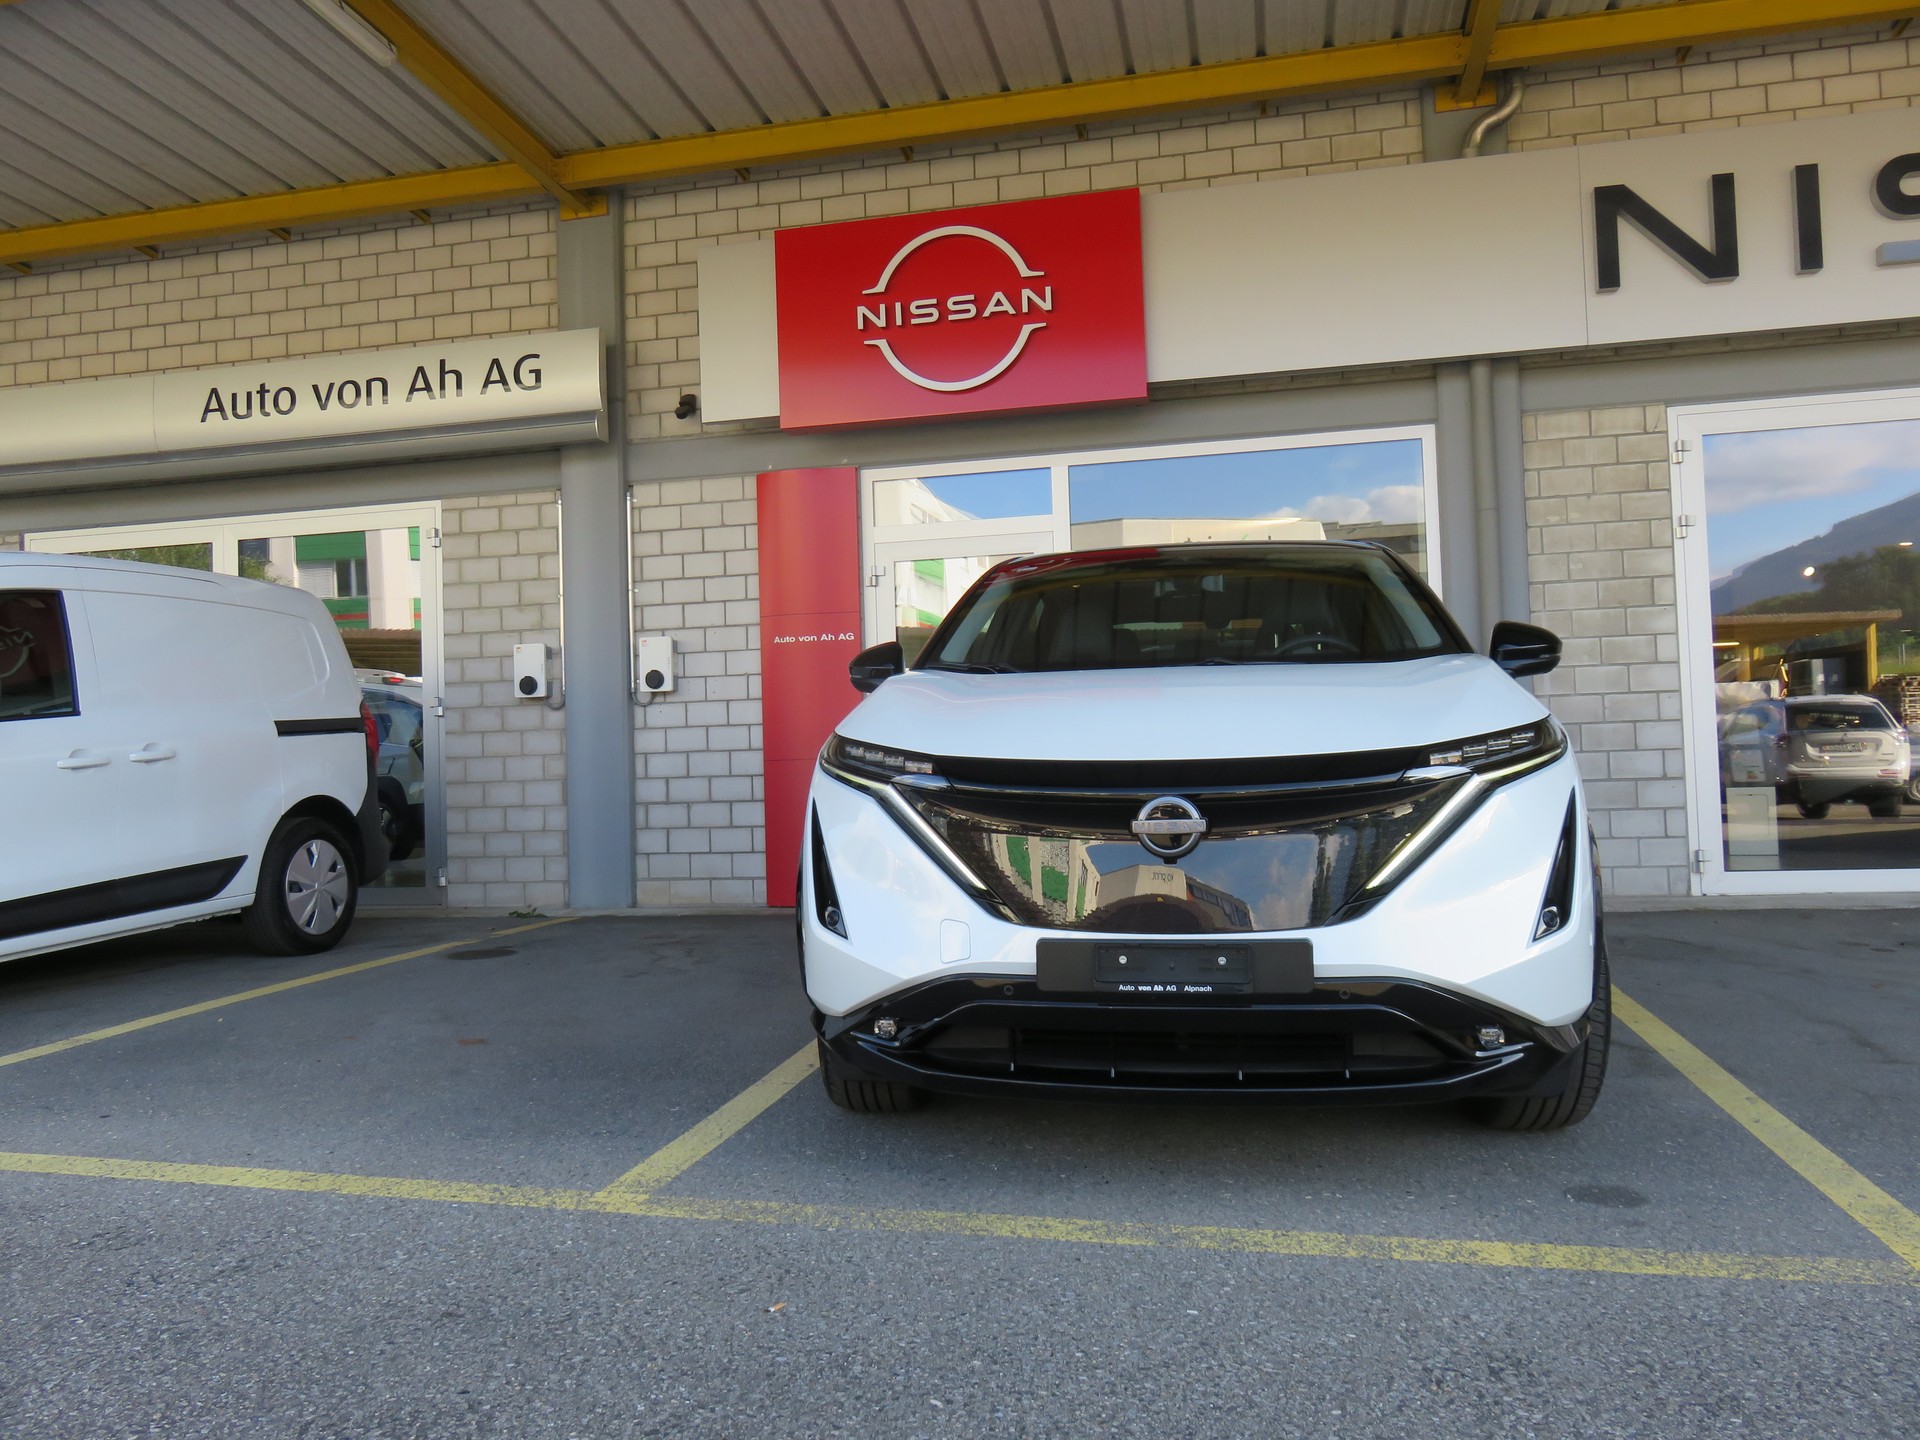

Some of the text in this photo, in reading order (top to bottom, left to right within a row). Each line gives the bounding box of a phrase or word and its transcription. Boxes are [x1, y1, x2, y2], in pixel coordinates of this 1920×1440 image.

[857, 286, 1052, 330] NISSAN
[200, 353, 542, 423] Auto von Ah AG
[798, 634, 818, 642] von
[820, 633, 835, 641] Ah
[1134, 821, 1204, 832] NISSAN
[1153, 984, 1164, 992] Ah
[1165, 984, 1177, 992] AG
[1183, 984, 1213, 993] Alpnach
